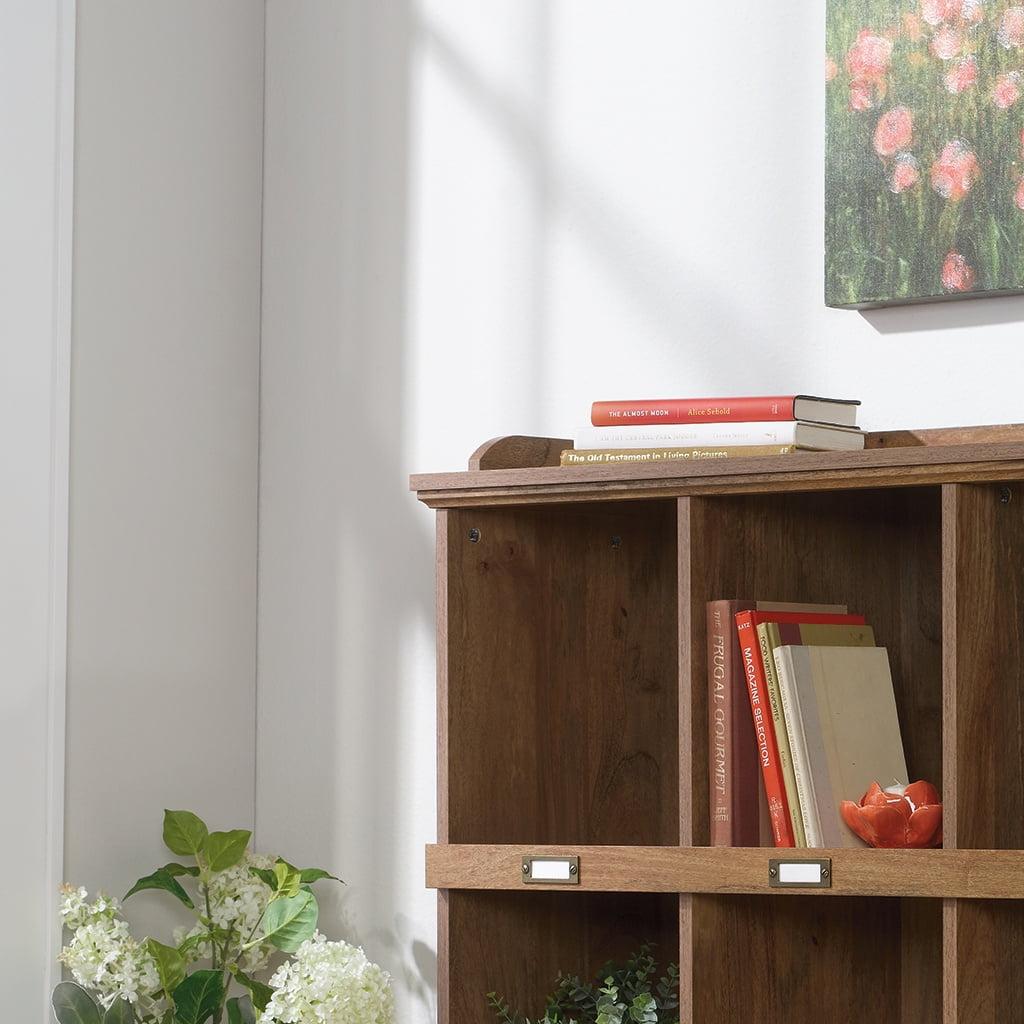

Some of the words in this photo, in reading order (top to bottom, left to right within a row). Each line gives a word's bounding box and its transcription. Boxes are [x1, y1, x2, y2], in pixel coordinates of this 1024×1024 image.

[608, 410, 621, 418] THE
[622, 410, 649, 418] ALMOST
[687, 407, 706, 416] Alice
[706, 407, 731, 416] Sebold
[568, 453, 585, 462] The
[587, 453, 603, 462] Old
[604, 452, 651, 462] Testament
[652, 451, 661, 459] in
[692, 450, 728, 460] Pictures
[713, 634, 725, 704] FRUGAL
[743, 647, 760, 705] MAGAZINE
[754, 707, 770, 767] SELECTION
[714, 708, 726, 795] GOURMET
